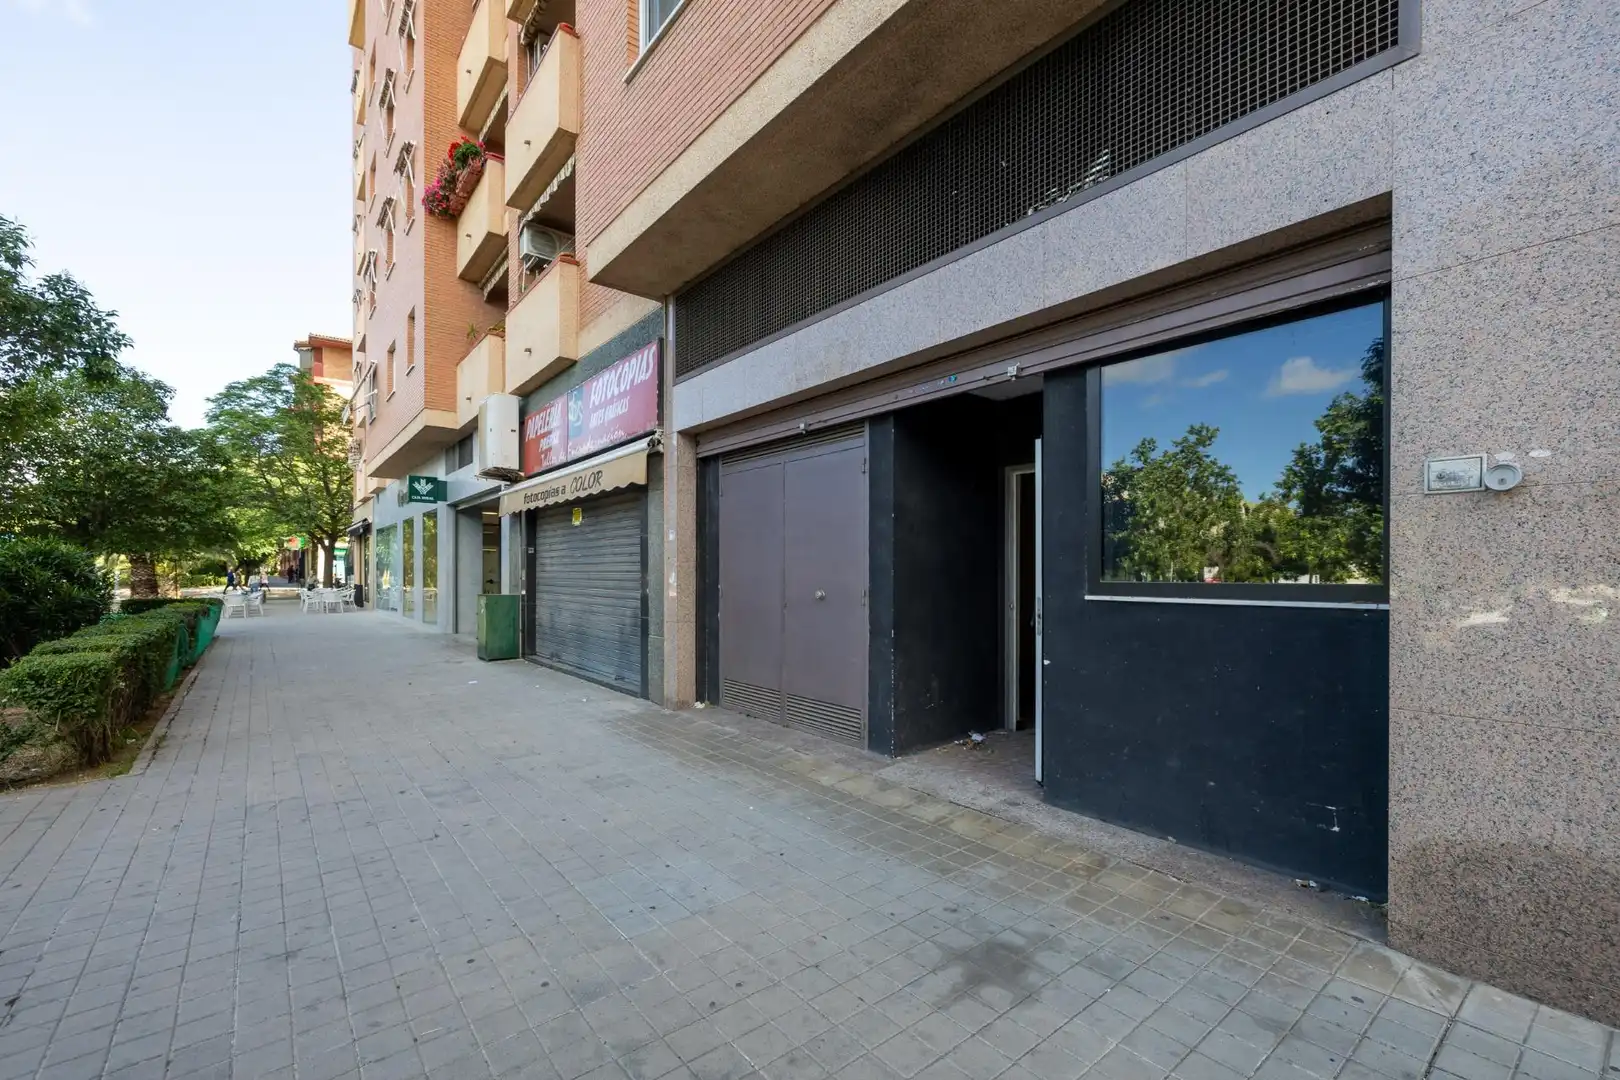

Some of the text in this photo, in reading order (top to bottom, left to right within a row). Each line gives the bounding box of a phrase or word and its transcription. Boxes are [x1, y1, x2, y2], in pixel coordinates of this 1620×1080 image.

[589, 345, 657, 408] FOTOCOPIAS
[523, 470, 604, 505] fotocopias a COLOR
